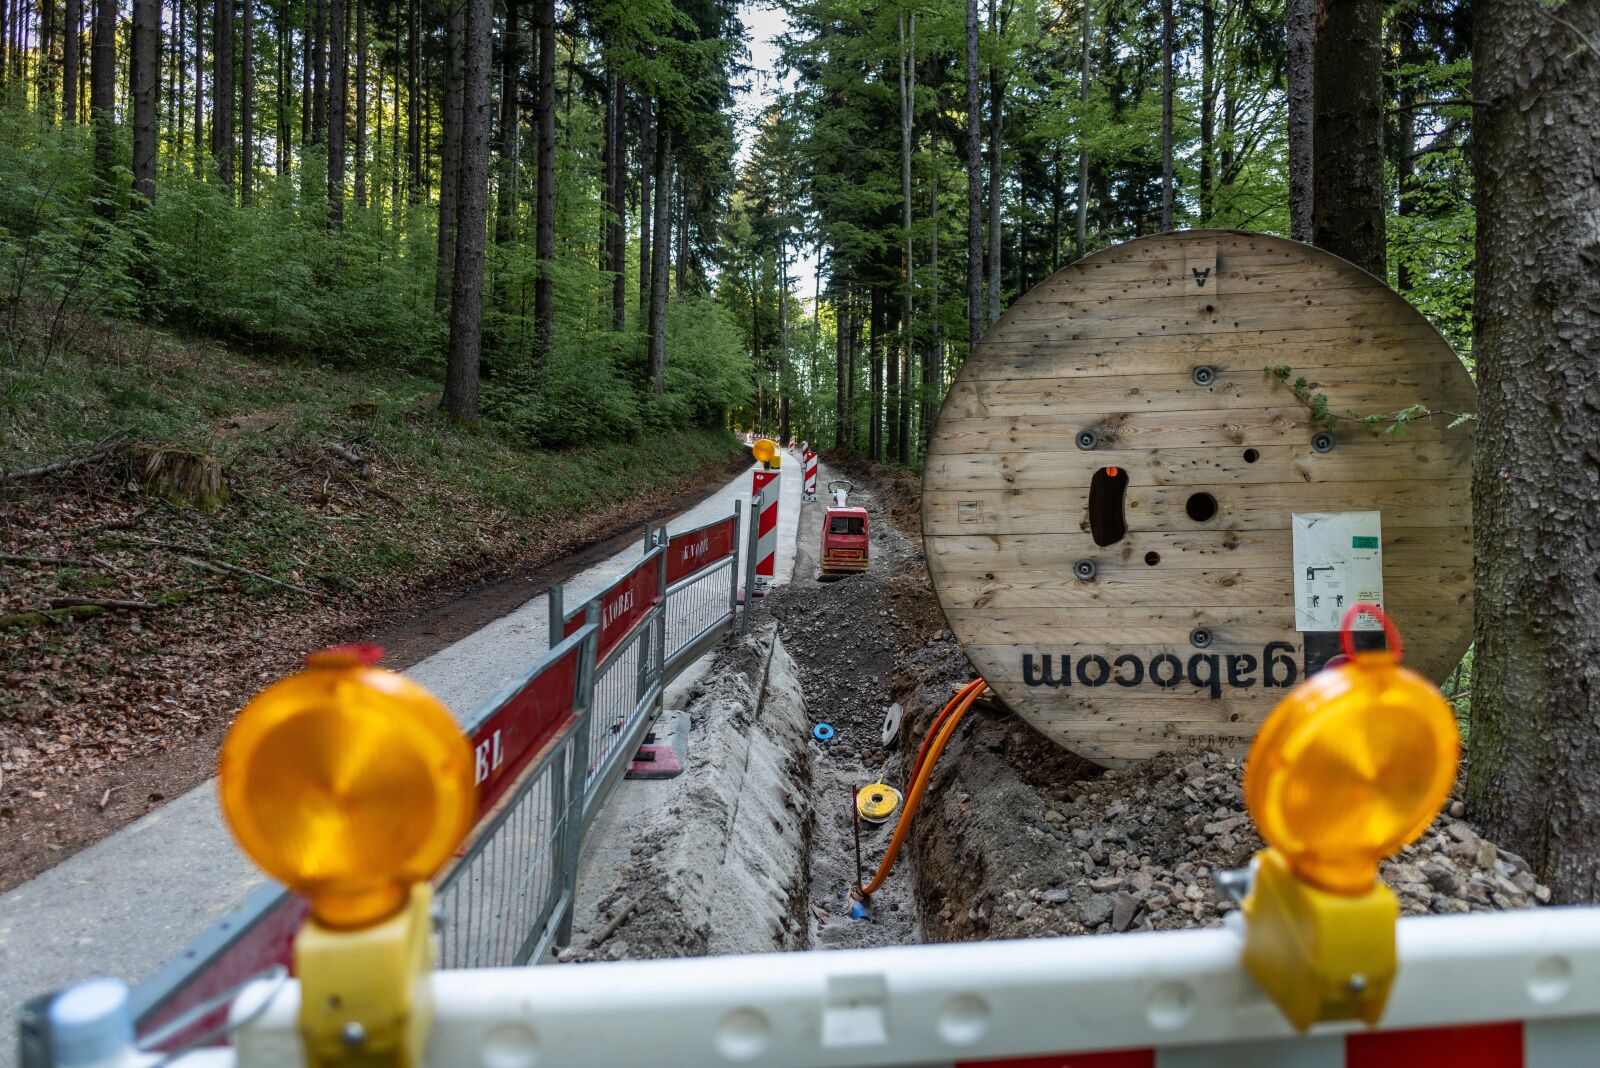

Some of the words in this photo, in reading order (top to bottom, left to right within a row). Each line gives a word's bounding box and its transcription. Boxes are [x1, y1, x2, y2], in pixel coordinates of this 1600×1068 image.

[1192, 268, 1211, 288] A
[602, 588, 634, 631] KNOBEL
[1022, 641, 1298, 700] gabocom
[474, 729, 504, 787] EL
